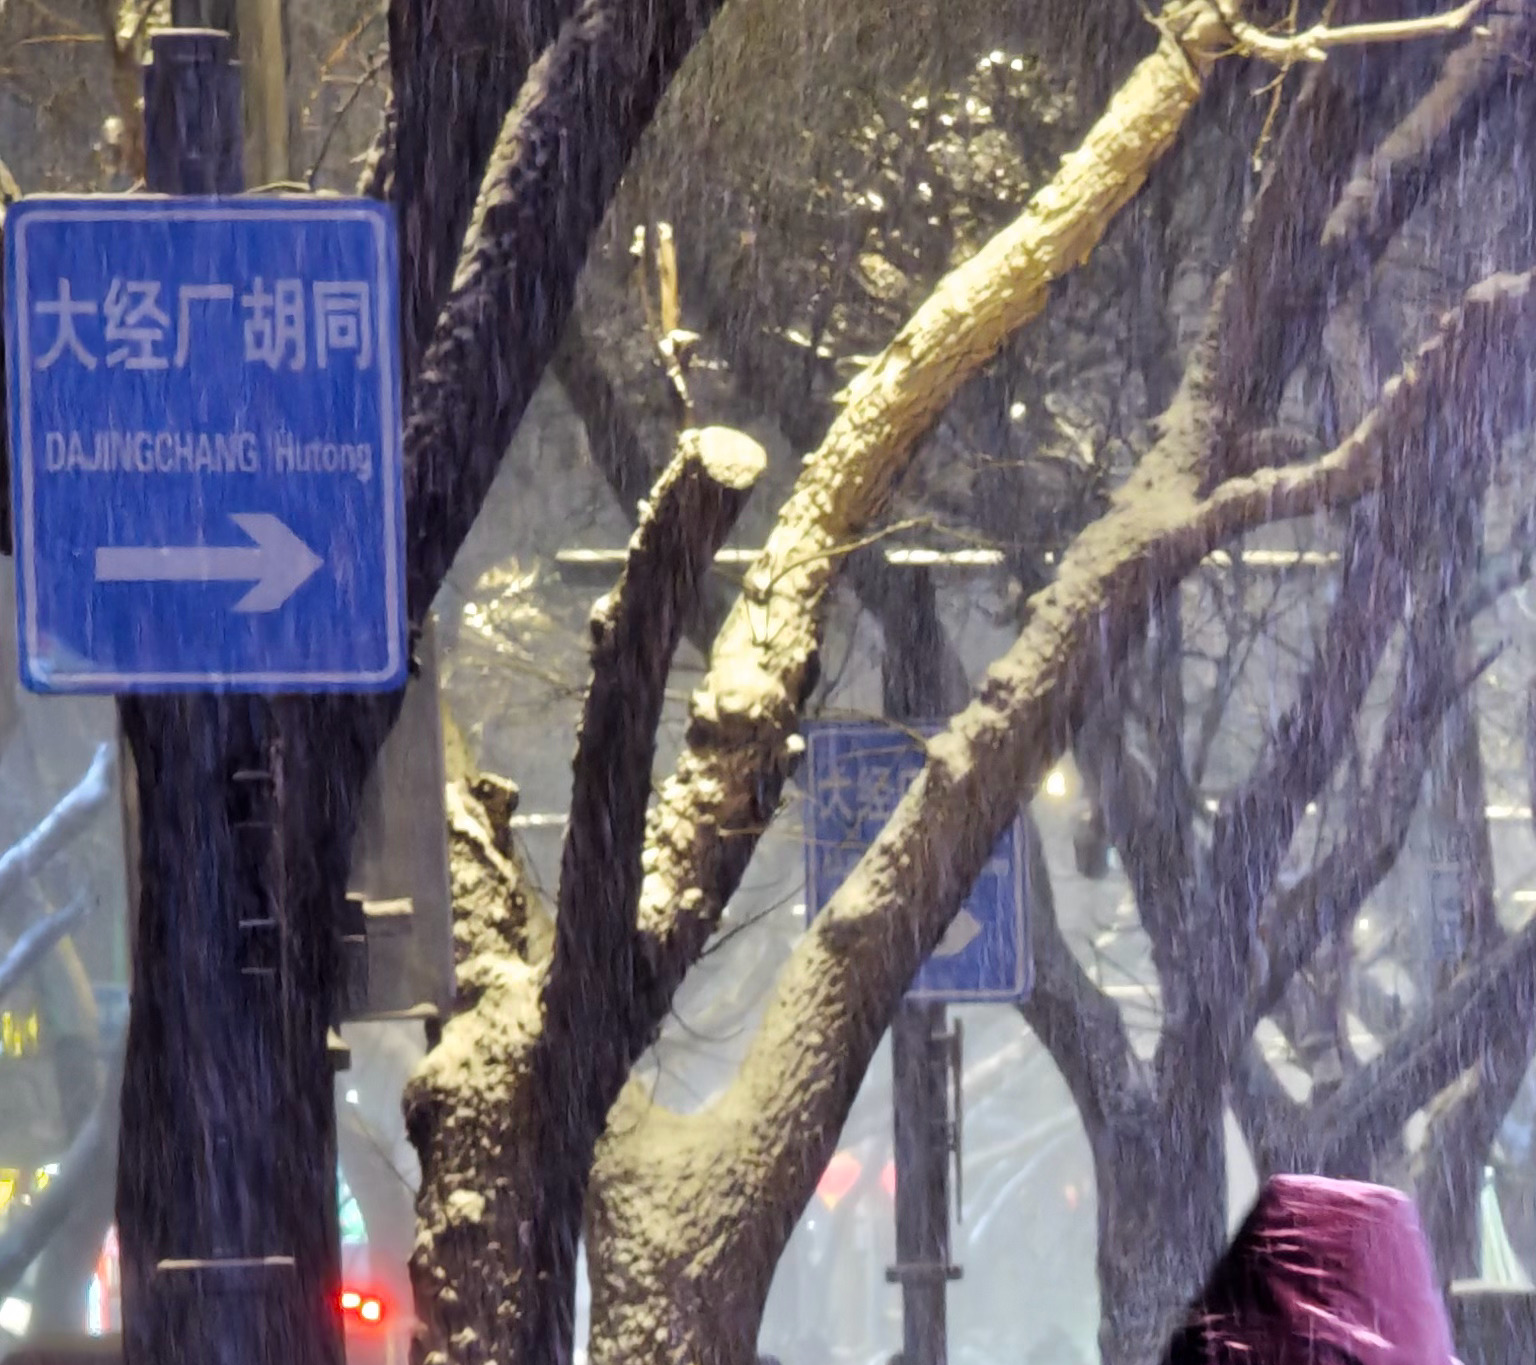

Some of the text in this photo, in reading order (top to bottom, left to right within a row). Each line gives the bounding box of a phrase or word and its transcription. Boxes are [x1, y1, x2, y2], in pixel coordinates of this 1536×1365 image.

[34, 277, 372, 370] 大经厂胡同
[45, 430, 373, 483] DAJINGCHANG Hutong
